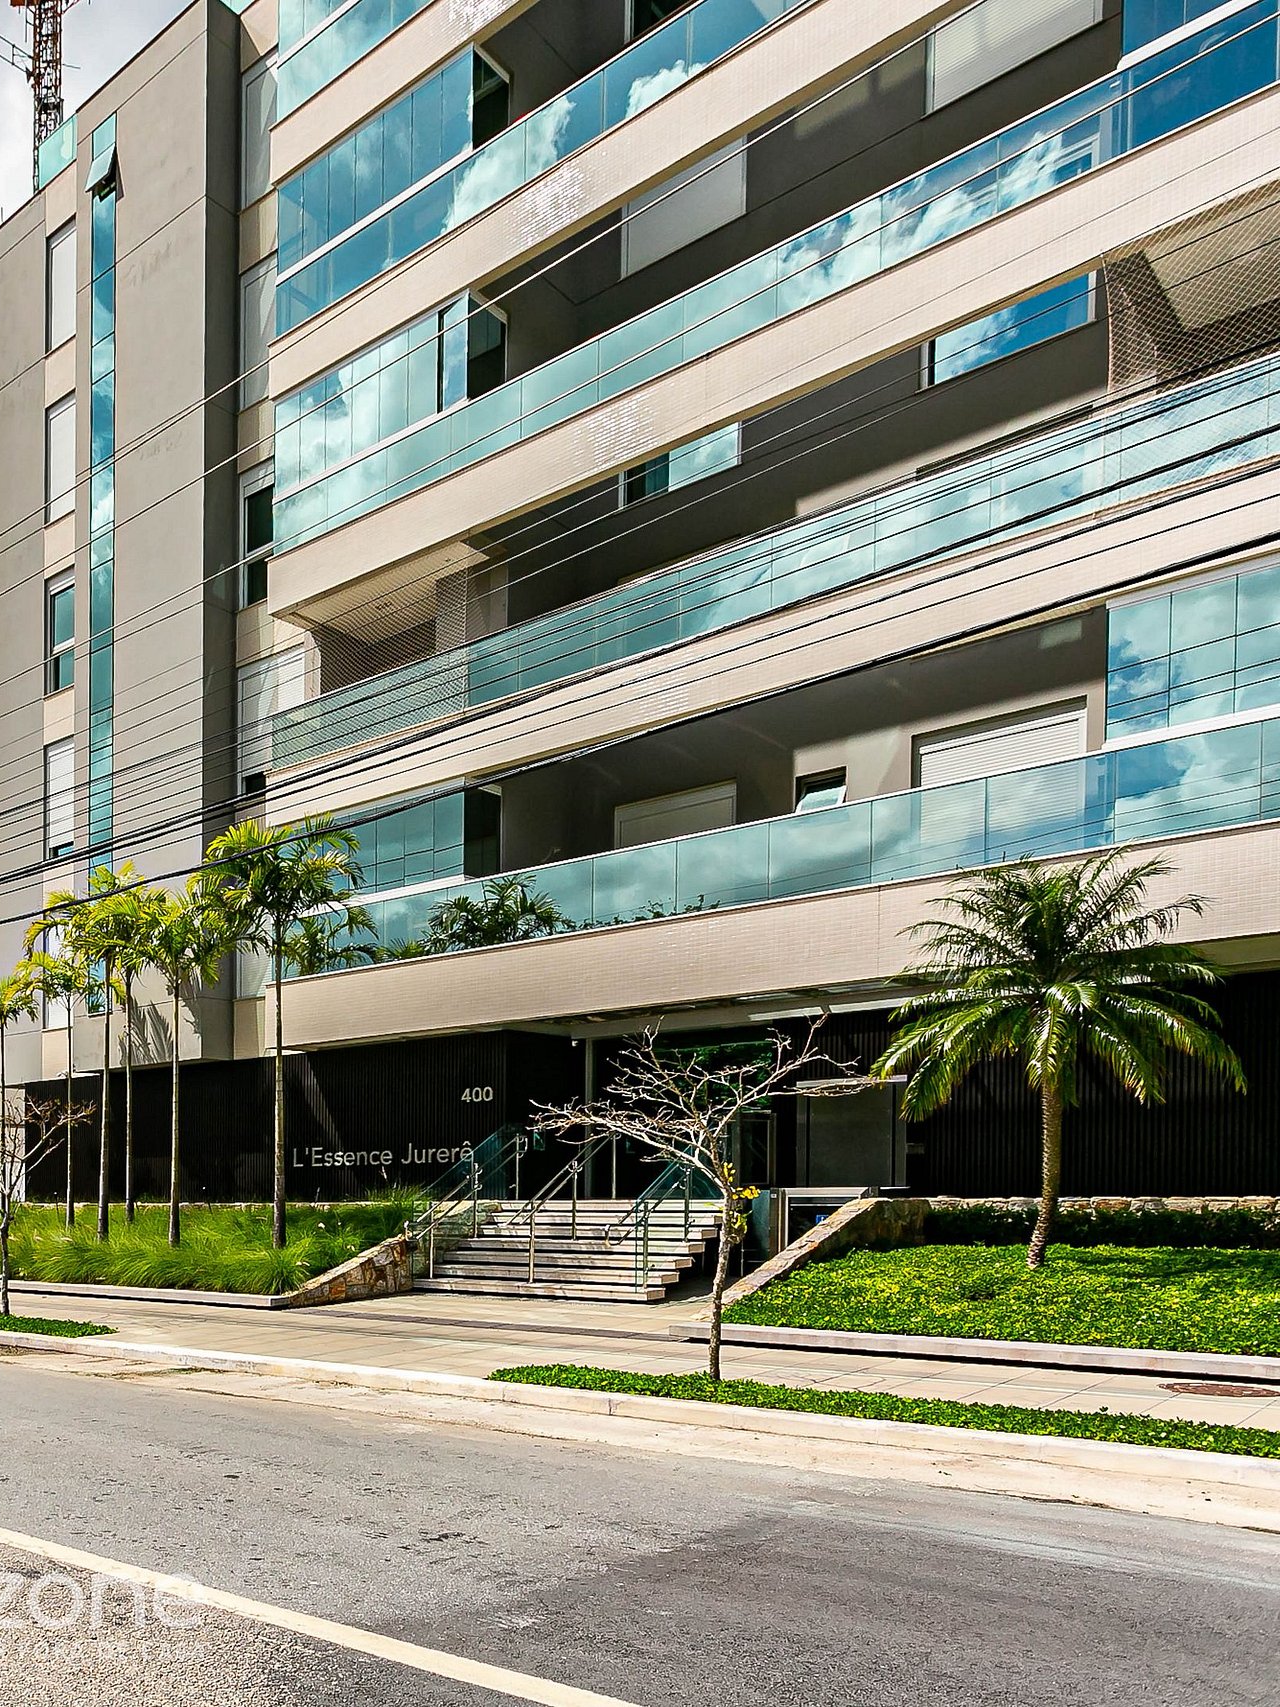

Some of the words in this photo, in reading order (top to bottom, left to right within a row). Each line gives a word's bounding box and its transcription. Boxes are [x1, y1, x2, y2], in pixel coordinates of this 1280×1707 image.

[461, 1086, 493, 1102] 400
[293, 1147, 393, 1167] L'Essence
[401, 1141, 475, 1165] Jurerê
